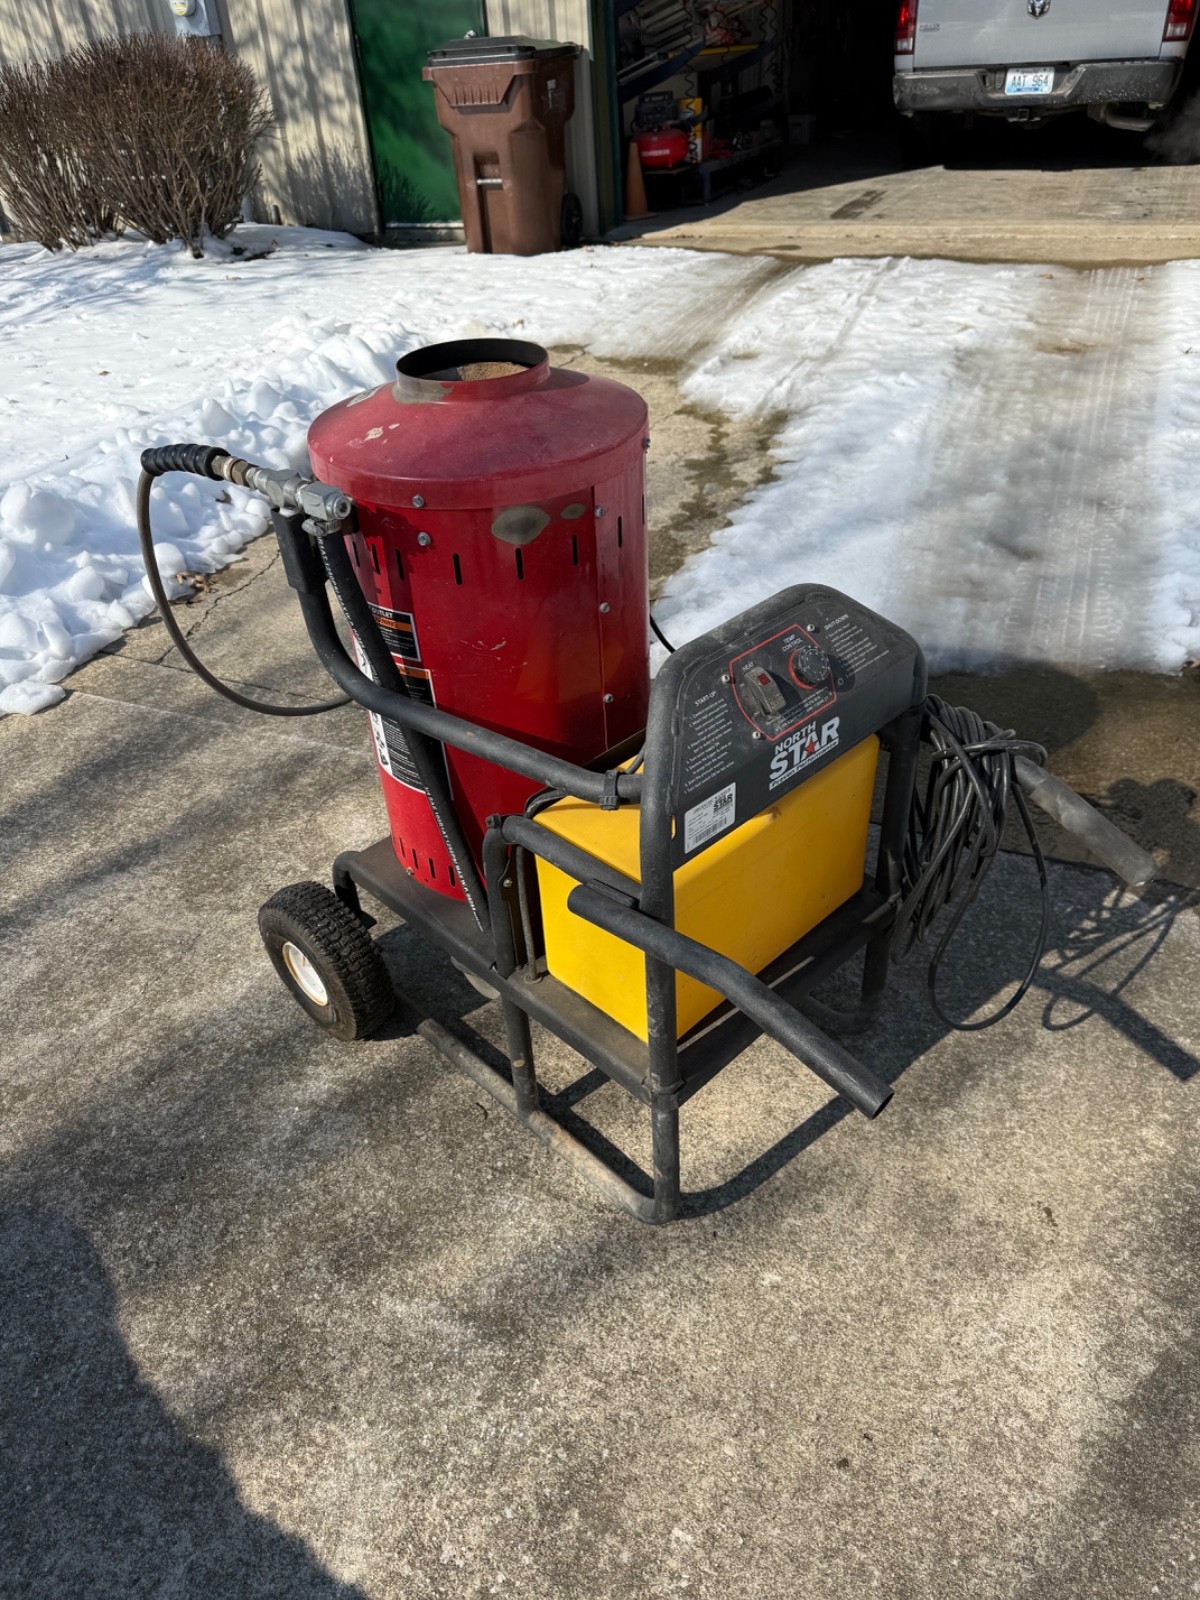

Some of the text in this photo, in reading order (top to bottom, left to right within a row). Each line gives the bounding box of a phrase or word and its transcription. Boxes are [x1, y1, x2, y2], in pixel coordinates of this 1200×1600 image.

[1011, 74, 1049, 88] AAT 964
[694, 690, 718, 707] START-UP
[769, 716, 840, 780] STAR
[775, 720, 816, 755] NORTH
